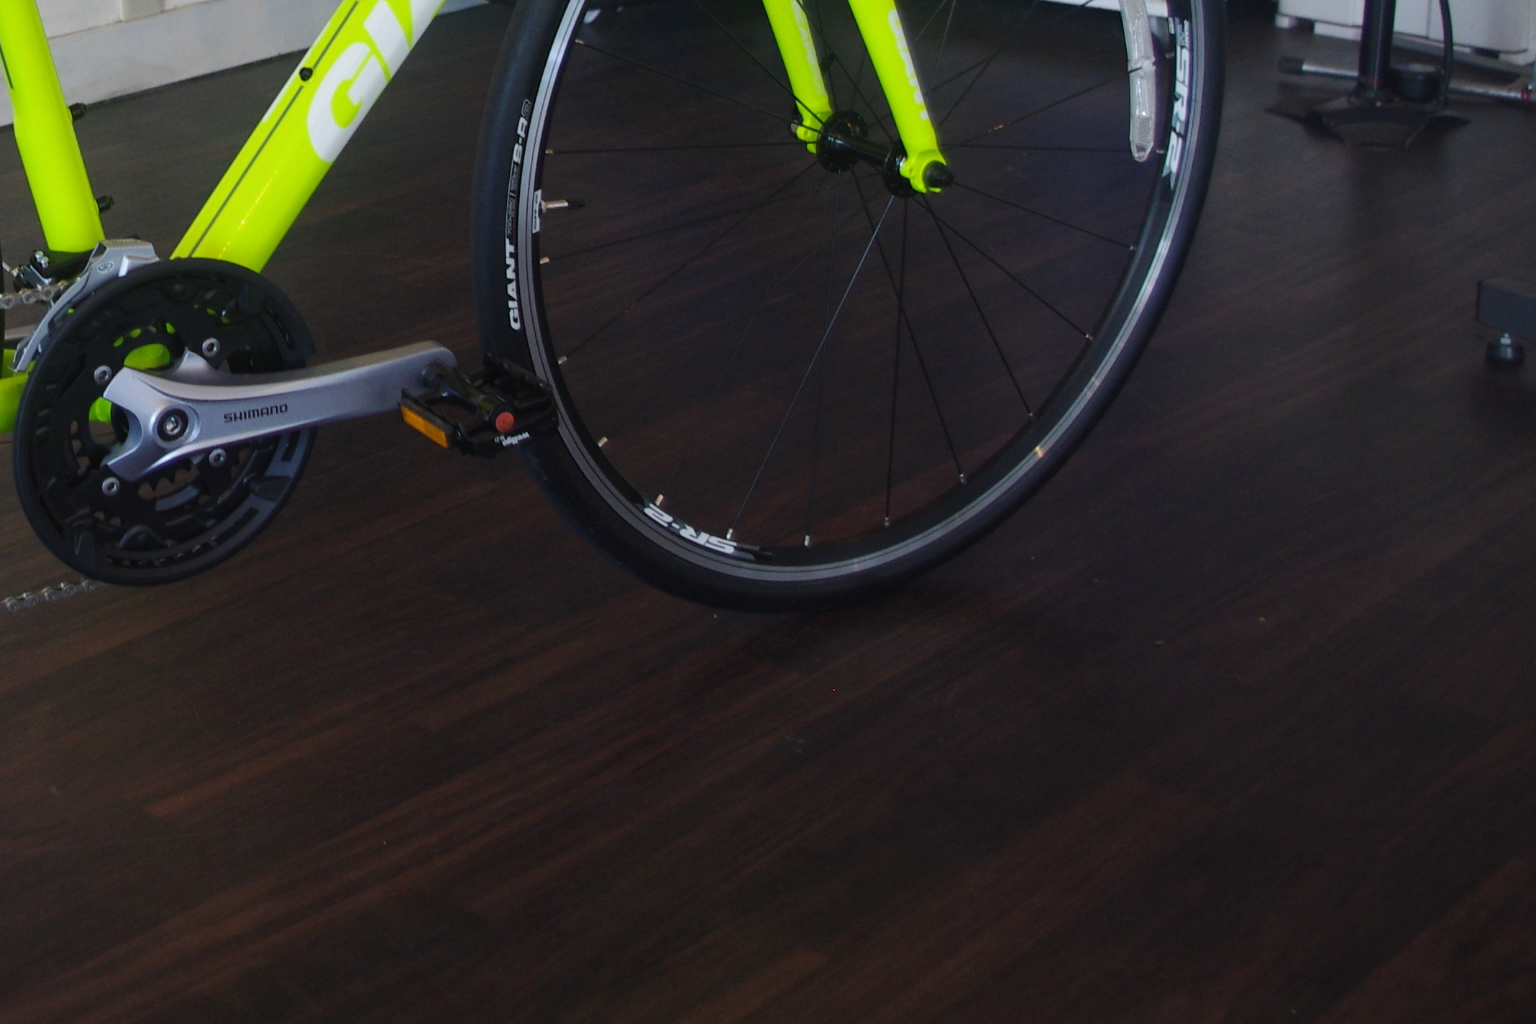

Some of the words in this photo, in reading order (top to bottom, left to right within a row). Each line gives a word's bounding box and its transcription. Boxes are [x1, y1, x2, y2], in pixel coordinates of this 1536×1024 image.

[1166, 45, 1190, 174] SR-2
[505, 237, 521, 331] GIANT
[223, 403, 289, 424] SHIMANO
[643, 502, 738, 555] SR-2
